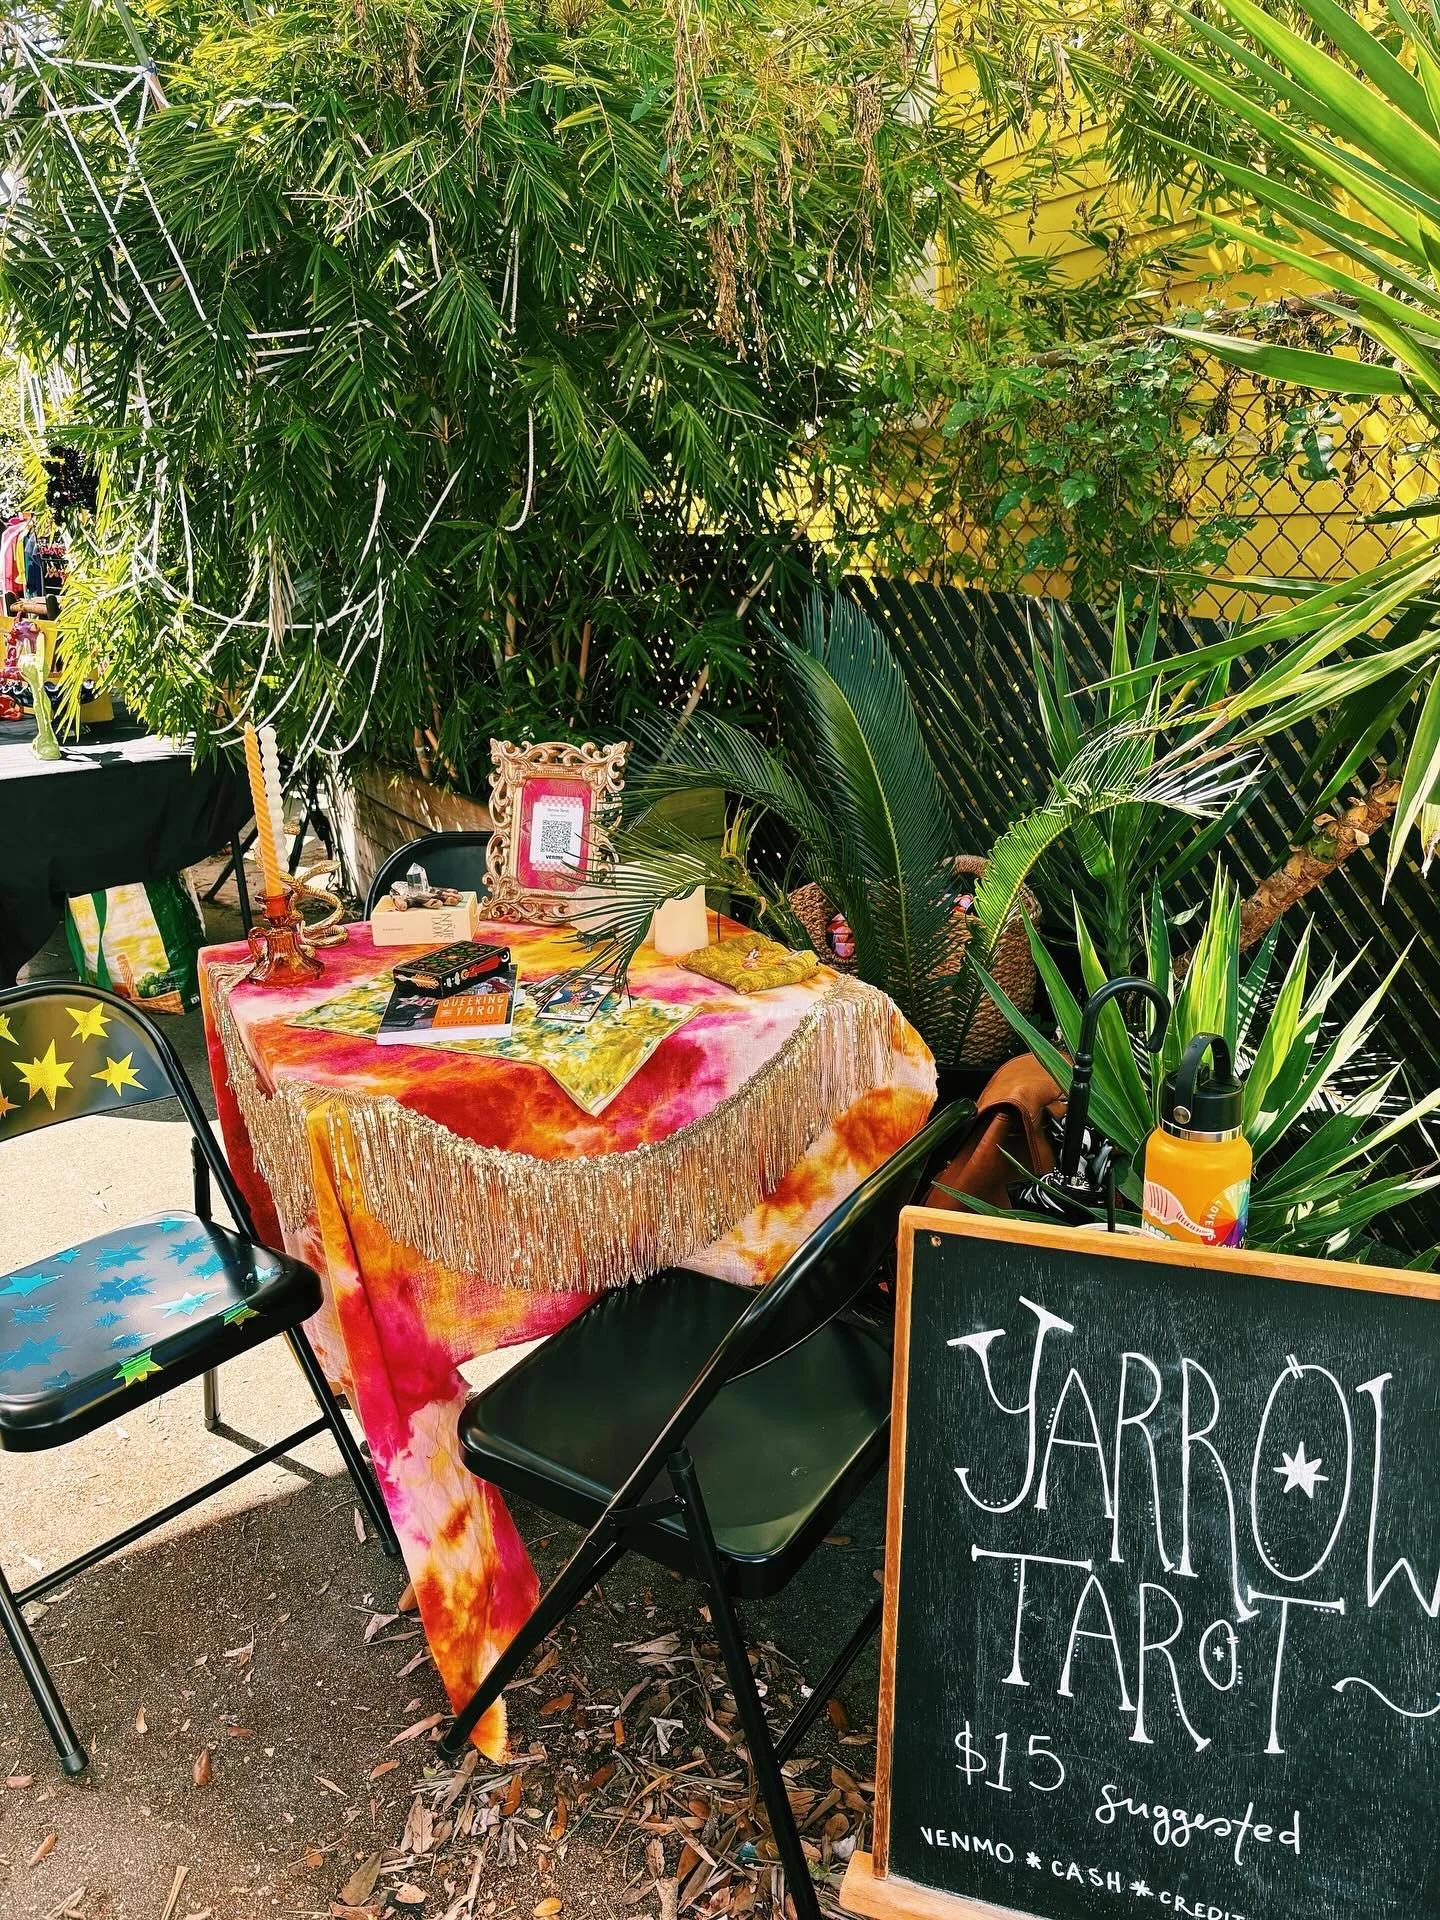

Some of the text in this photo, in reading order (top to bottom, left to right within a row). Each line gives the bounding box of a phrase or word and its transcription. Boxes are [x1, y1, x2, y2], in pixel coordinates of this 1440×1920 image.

[442, 995, 505, 1008] QUEERING
[456, 1004, 504, 1017] TAROT
[1205, 1200, 1223, 1226] LOVE
[947, 1296, 1440, 1622] YARROW
[972, 1543, 1345, 1755] TAROT
[954, 1720, 1301, 1867] $15 suggested
[920, 1826, 1014, 1864] VENMO
[1051, 1860, 1121, 1894] CASH
